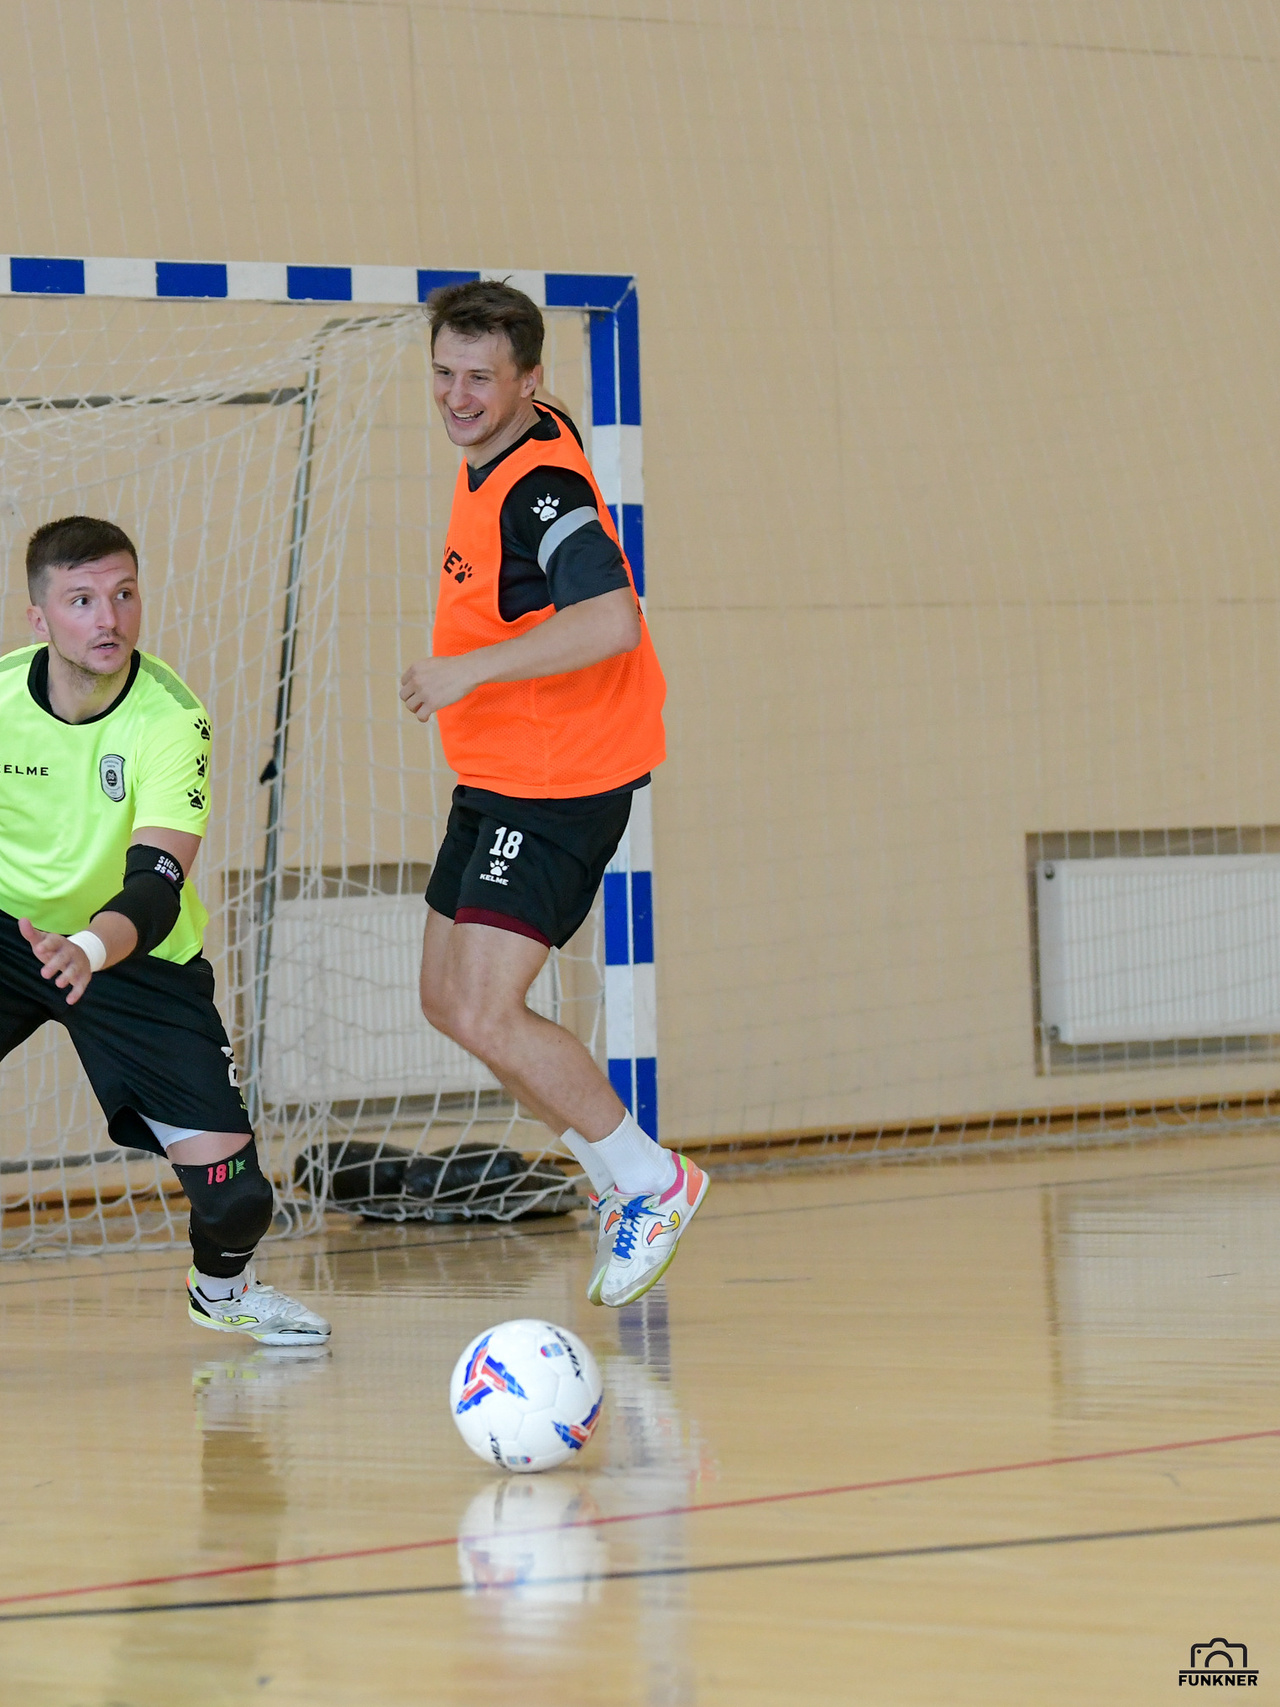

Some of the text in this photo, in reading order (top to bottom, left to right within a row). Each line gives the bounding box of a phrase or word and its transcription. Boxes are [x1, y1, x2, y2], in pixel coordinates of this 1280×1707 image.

[489, 826, 524, 860] 18
[158, 855, 180, 879] SHEVA
[479, 873, 509, 886] KELME
